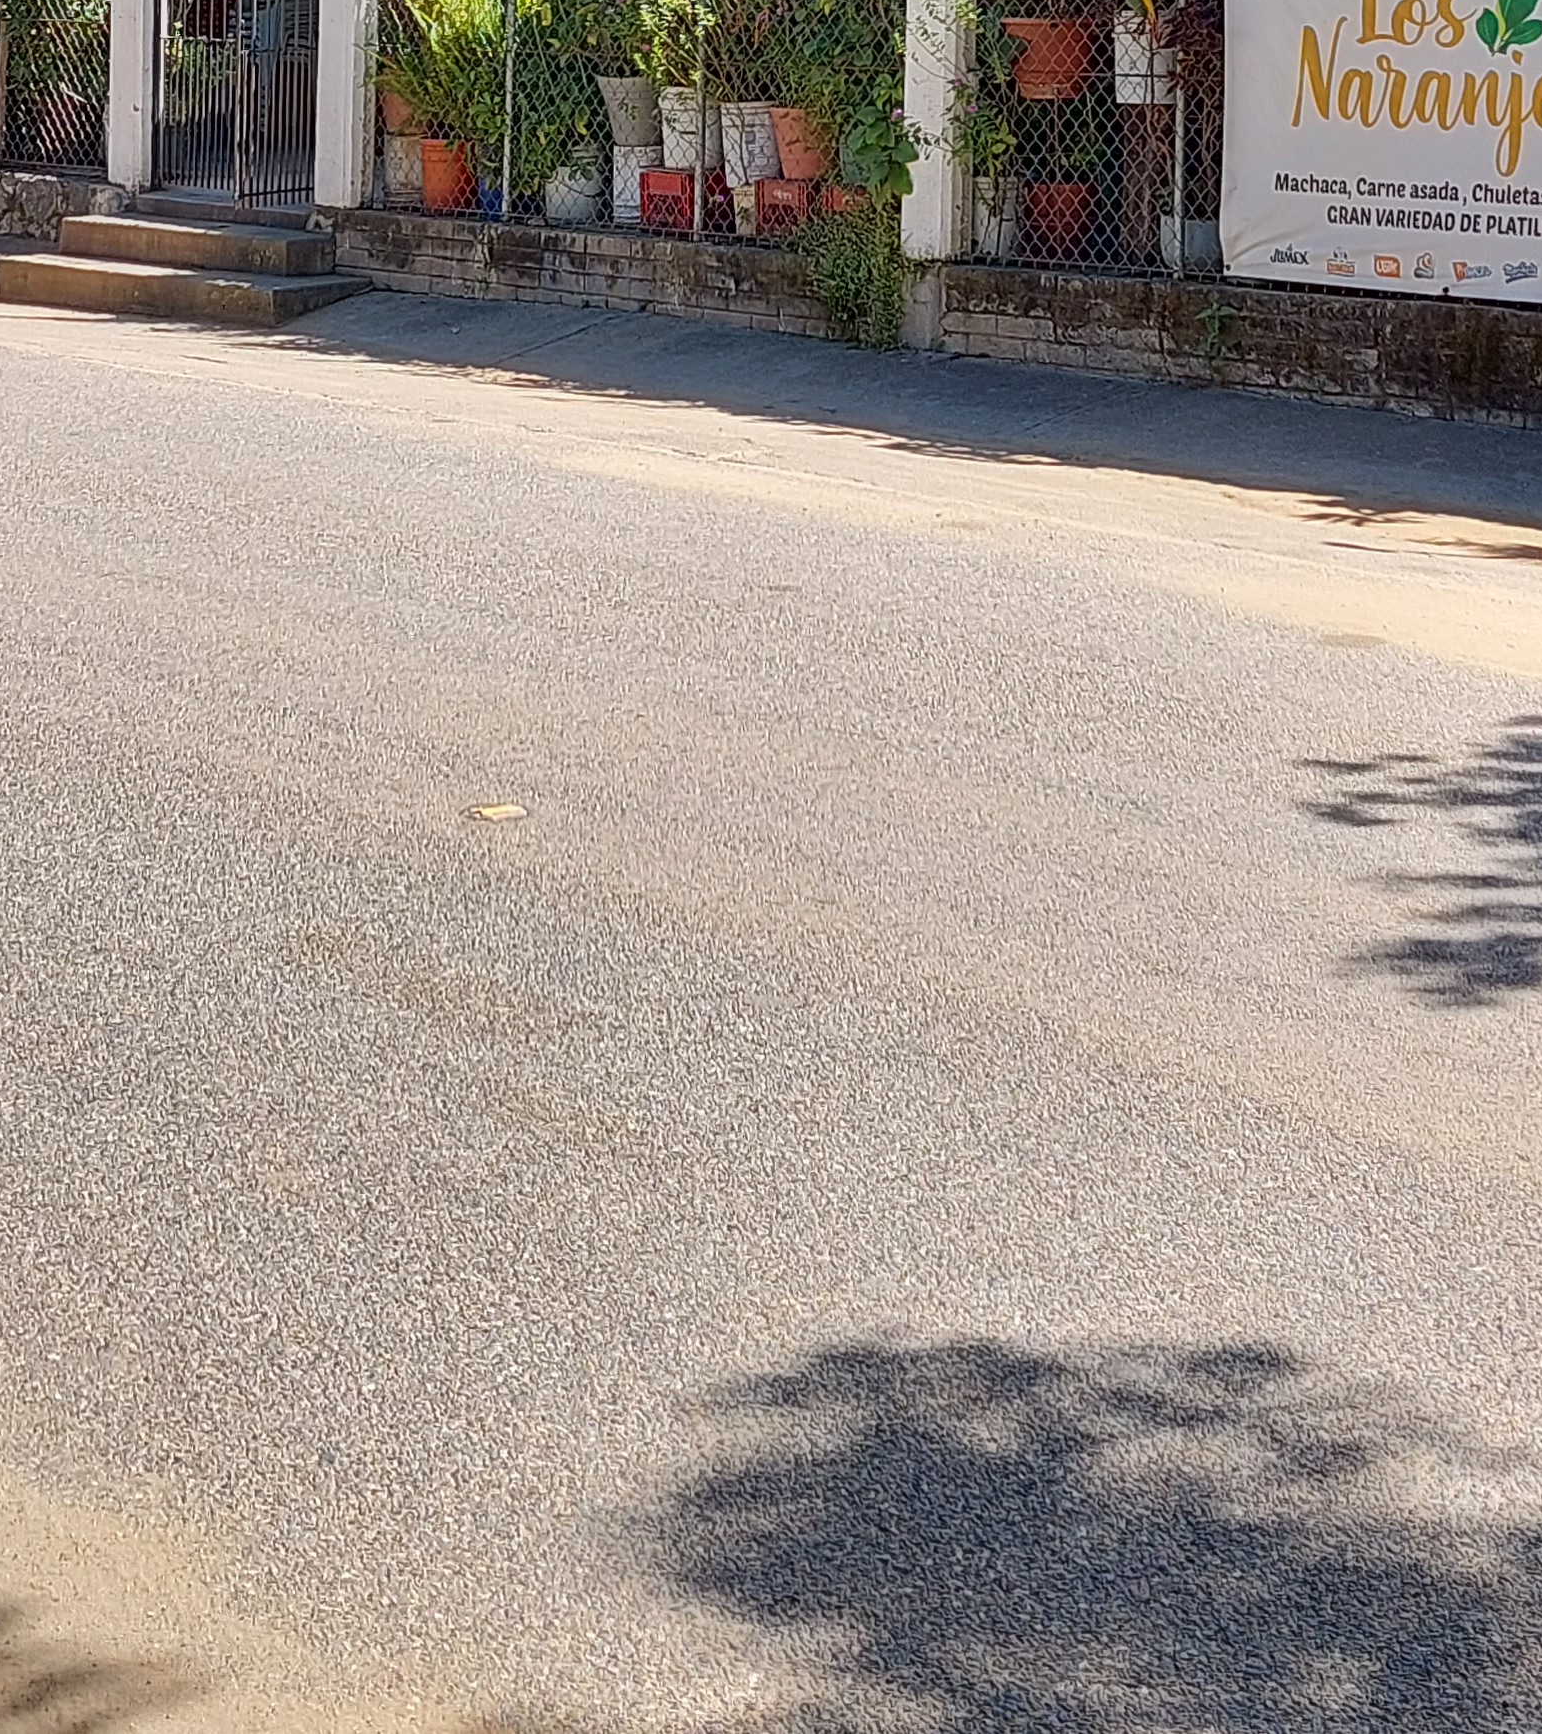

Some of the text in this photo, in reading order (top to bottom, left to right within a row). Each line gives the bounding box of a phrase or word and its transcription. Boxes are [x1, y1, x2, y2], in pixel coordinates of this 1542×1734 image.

[1274, 172, 1352, 200] Machaca,
[1356, 177, 1406, 199] Carne
[1327, 206, 1372, 227] GRAN
[1375, 208, 1455, 232] VARIEDAD
[1459, 213, 1482, 233] DE
